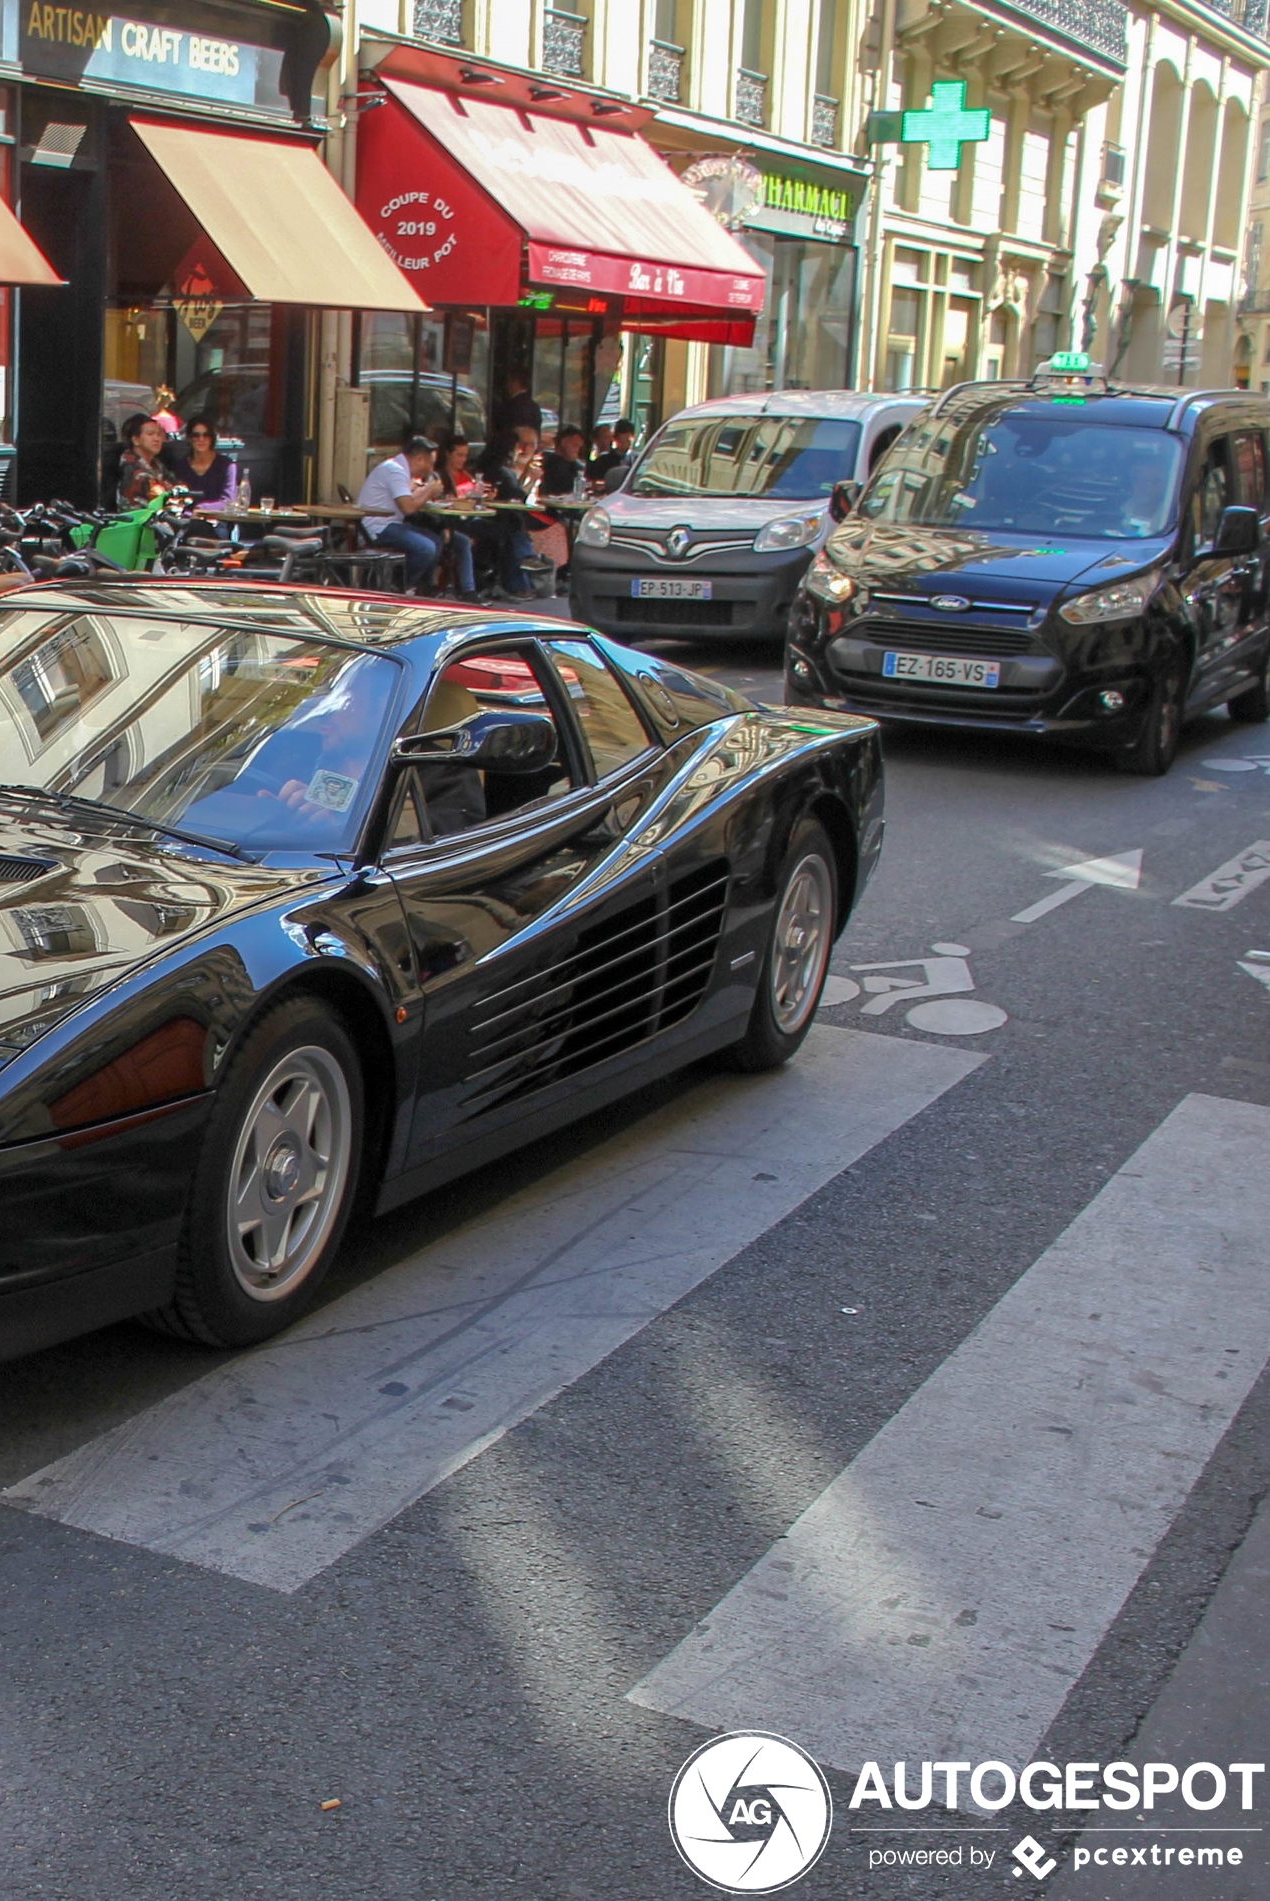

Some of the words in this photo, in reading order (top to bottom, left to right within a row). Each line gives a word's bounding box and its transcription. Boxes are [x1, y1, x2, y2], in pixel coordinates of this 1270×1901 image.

[27, 1, 112, 53] ARTISAN
[121, 22, 183, 65] CRAFT
[189, 36, 239, 76] BEERS
[380, 192, 429, 218] COUPE
[433, 198, 454, 220] DU
[397, 221, 436, 236] 2019
[433, 233, 457, 263] POT
[640, 582, 702, 597] EP-513-JP
[896, 656, 985, 681] EZ-165-VS
